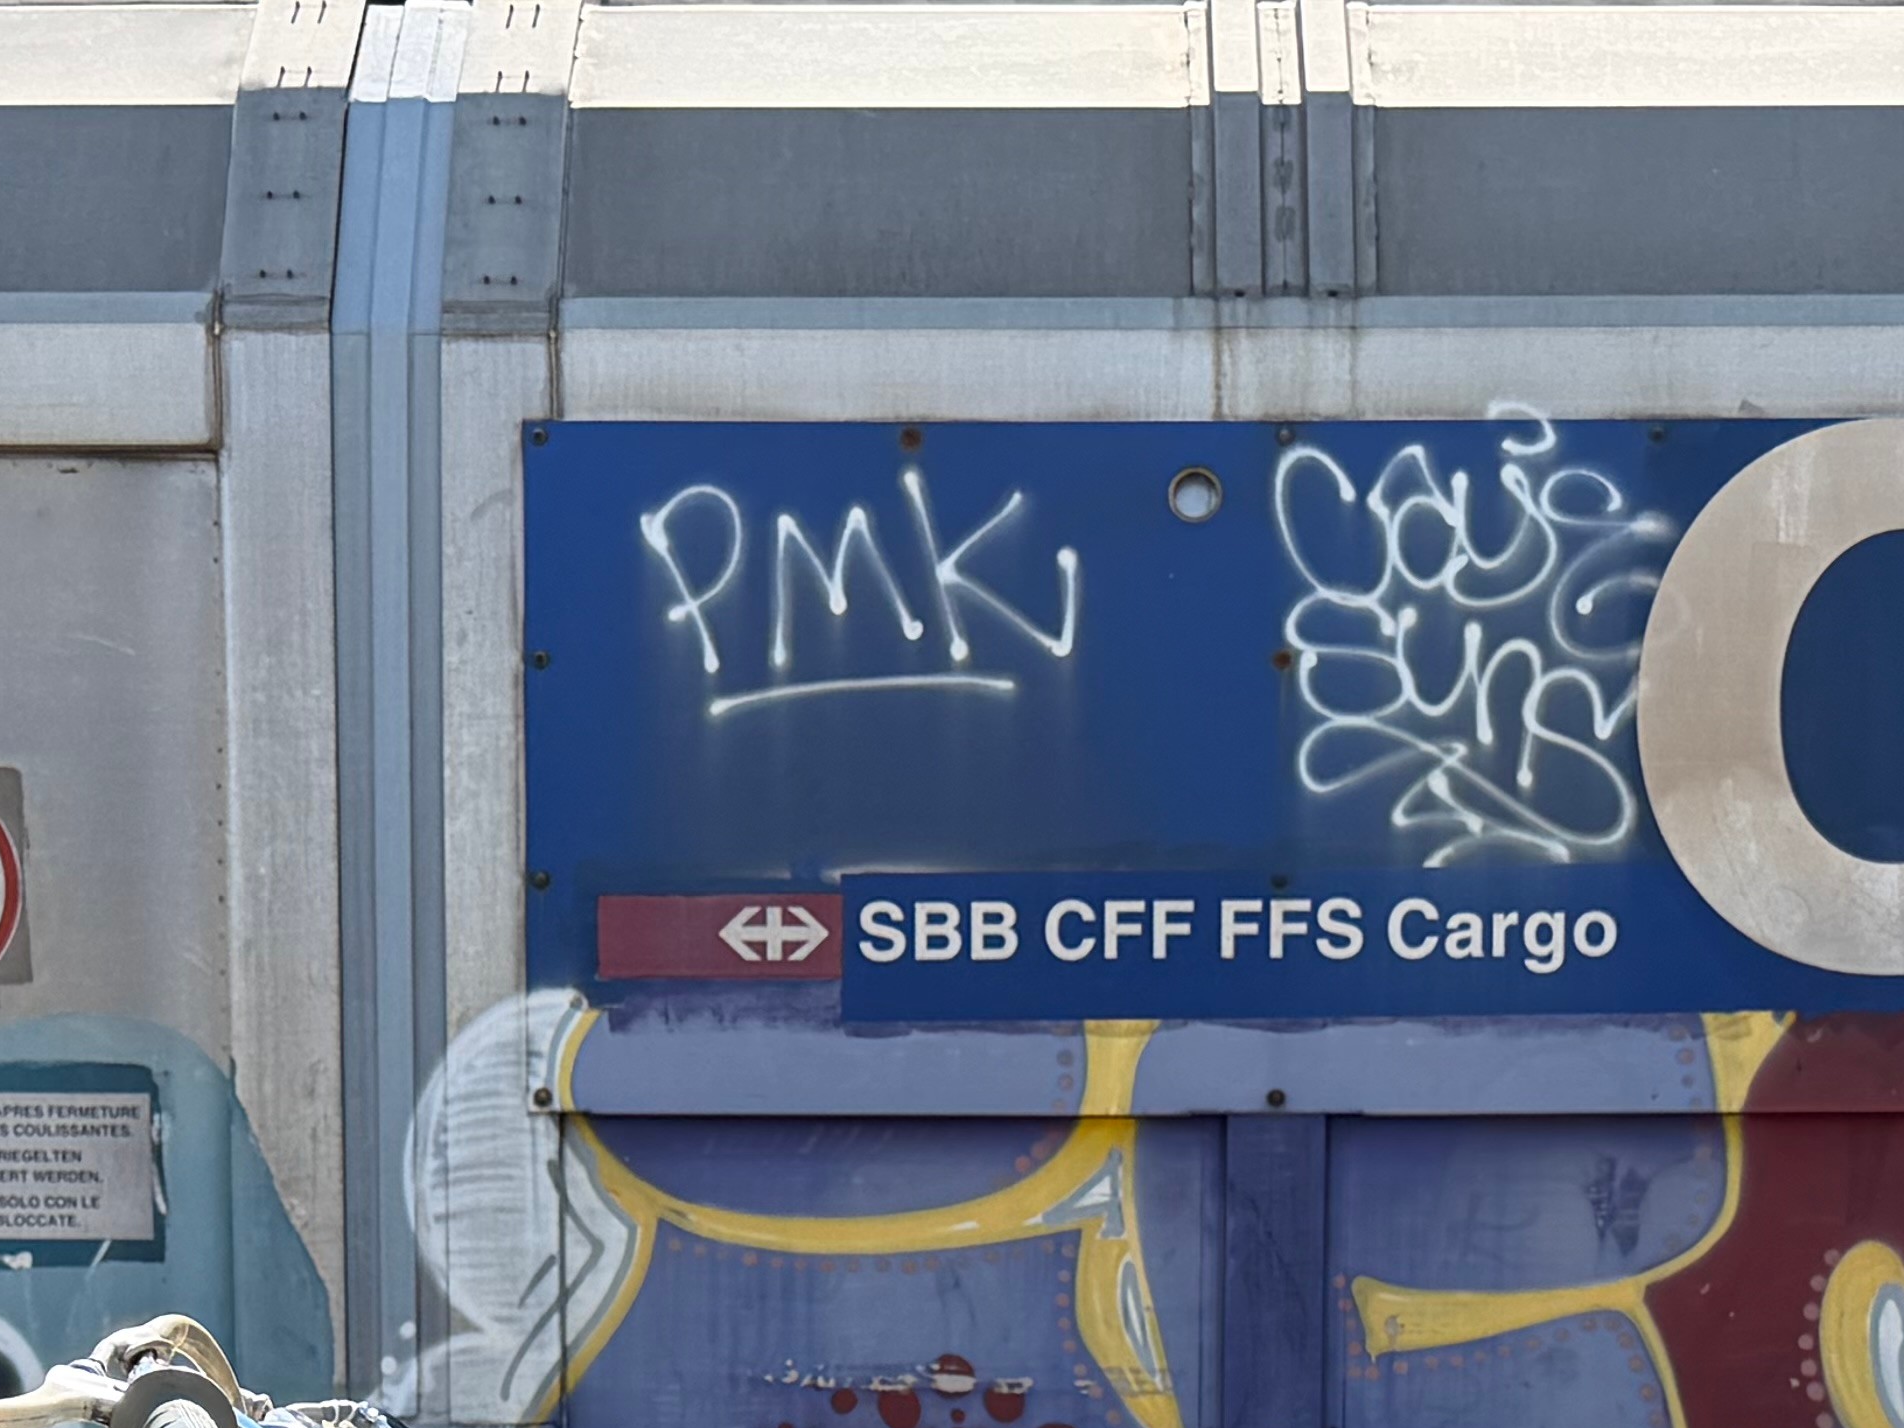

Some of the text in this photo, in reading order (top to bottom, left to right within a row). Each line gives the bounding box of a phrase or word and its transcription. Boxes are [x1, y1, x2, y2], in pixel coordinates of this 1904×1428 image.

[859, 898, 1618, 974] SBB CFF FFS Cargo
[48, 1105, 141, 1119] FERMETURE
[33, 1169, 104, 1184] WERDEN.
[44, 1196, 78, 1209] CON
[82, 1196, 101, 1209] LE
